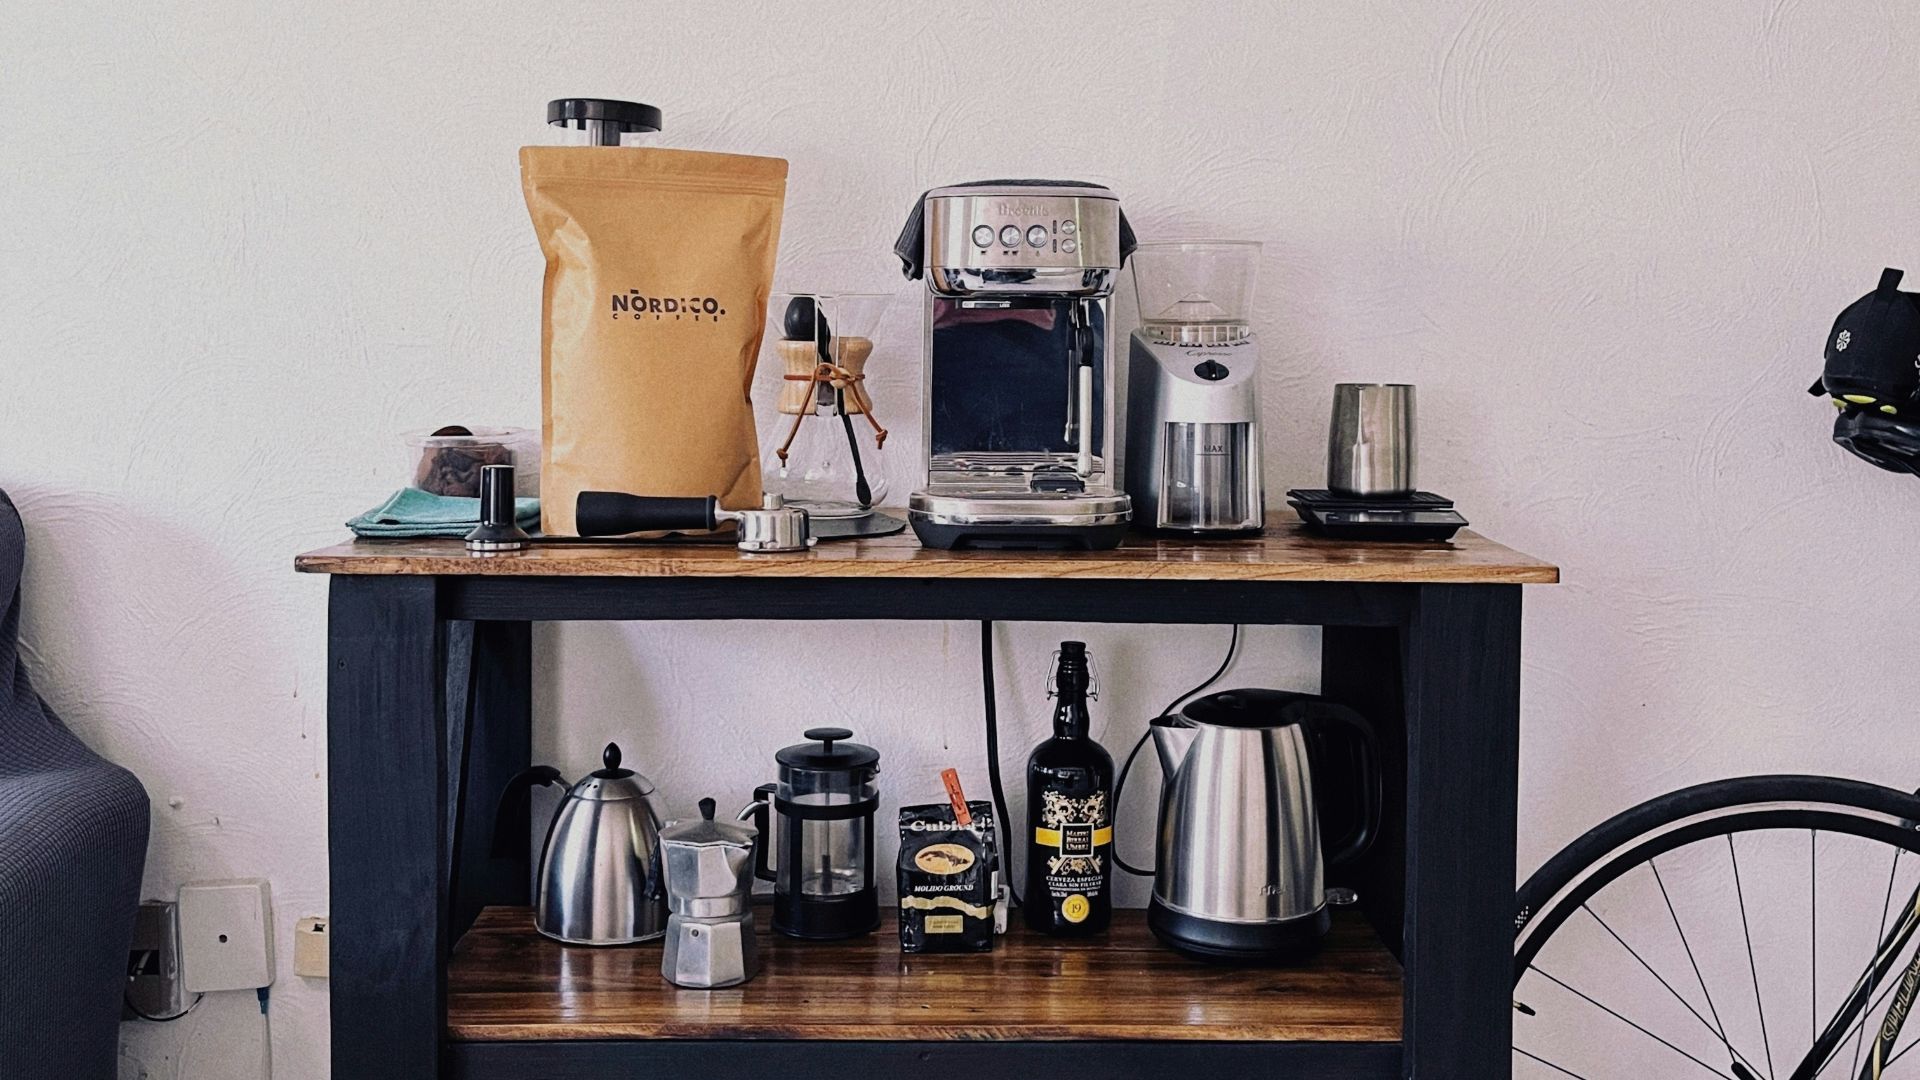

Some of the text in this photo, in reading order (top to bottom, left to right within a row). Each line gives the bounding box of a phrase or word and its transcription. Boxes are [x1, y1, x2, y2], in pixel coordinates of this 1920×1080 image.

[612, 313, 718, 322] COFFEE
[1204, 444, 1223, 453] MAX
[1077, 874, 1103, 882] ESPECIAL
[1072, 903, 1082, 914] 19
